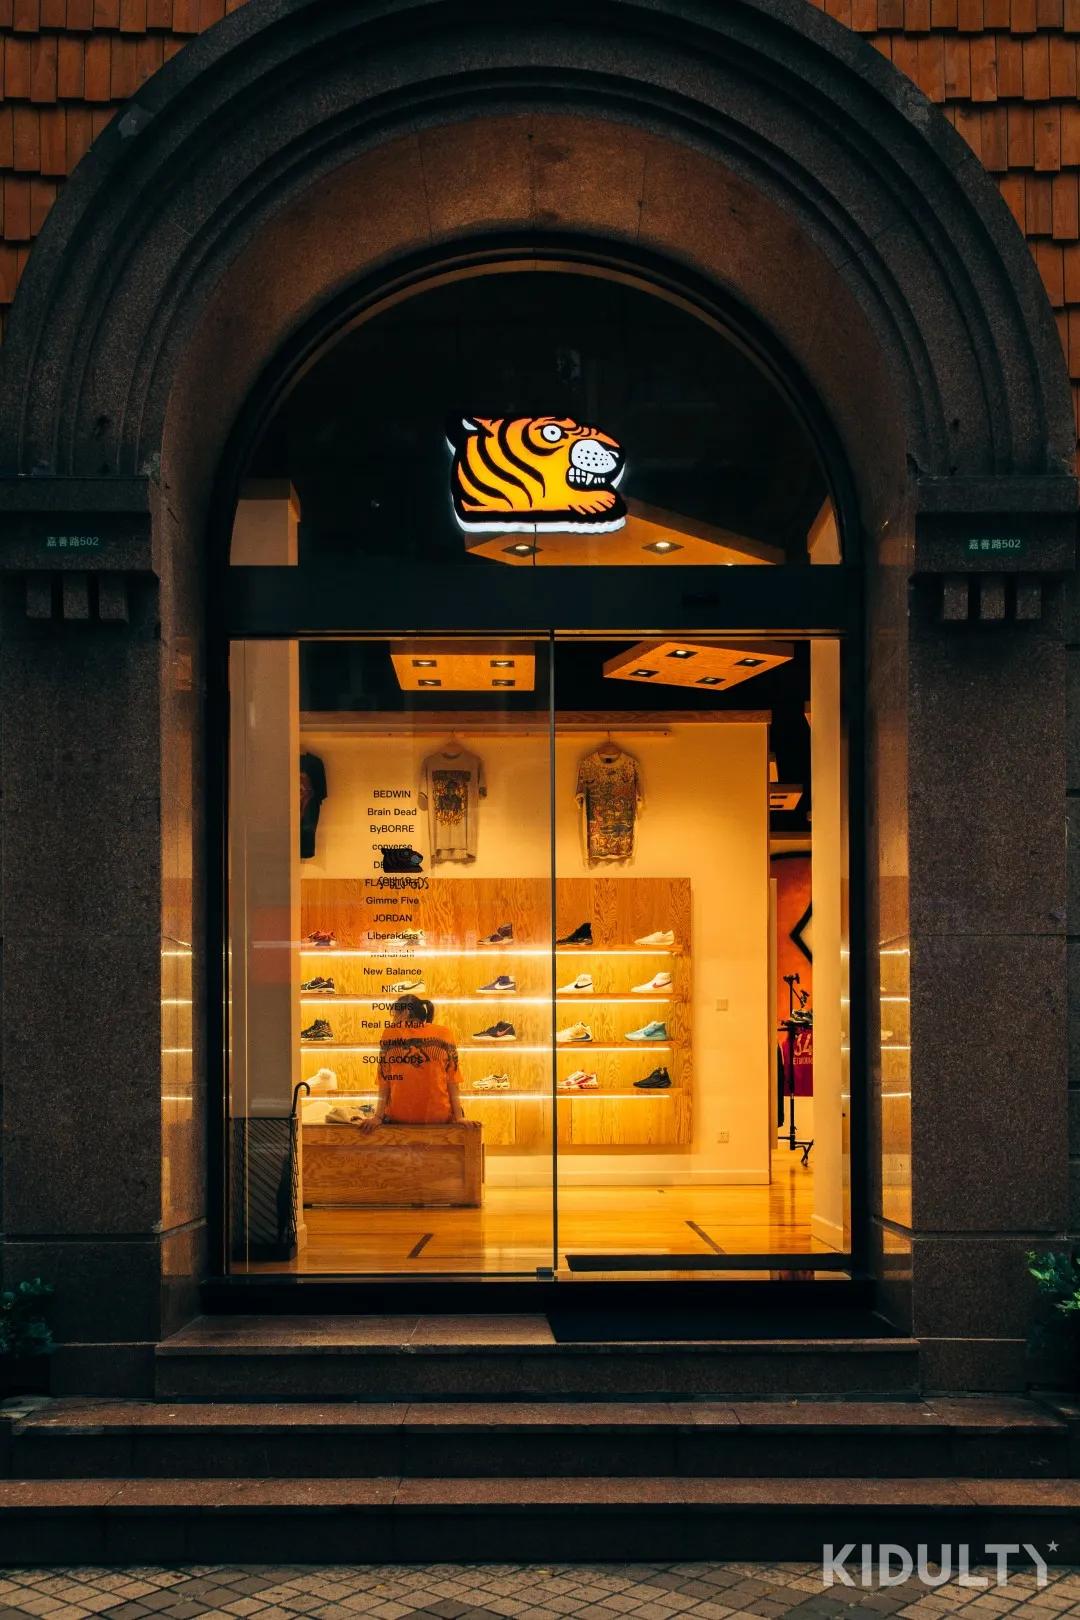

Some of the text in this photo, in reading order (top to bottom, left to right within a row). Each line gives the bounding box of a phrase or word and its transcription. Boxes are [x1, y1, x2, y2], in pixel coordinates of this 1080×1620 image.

[373, 790, 411, 798] BEDWIN
[367, 808, 417, 816] Brain Dead
[370, 825, 415, 834] ByBORRE
[365, 896, 420, 905] Gimme Five
[373, 914, 413, 922] JORDAN
[363, 967, 422, 976] New Balance
[381, 985, 404, 993] NIKE
[372, 1003, 414, 1011] POWERS
[361, 1020, 425, 1029] Real Bad Man
[362, 1055, 424, 1064] SOULGOODS
